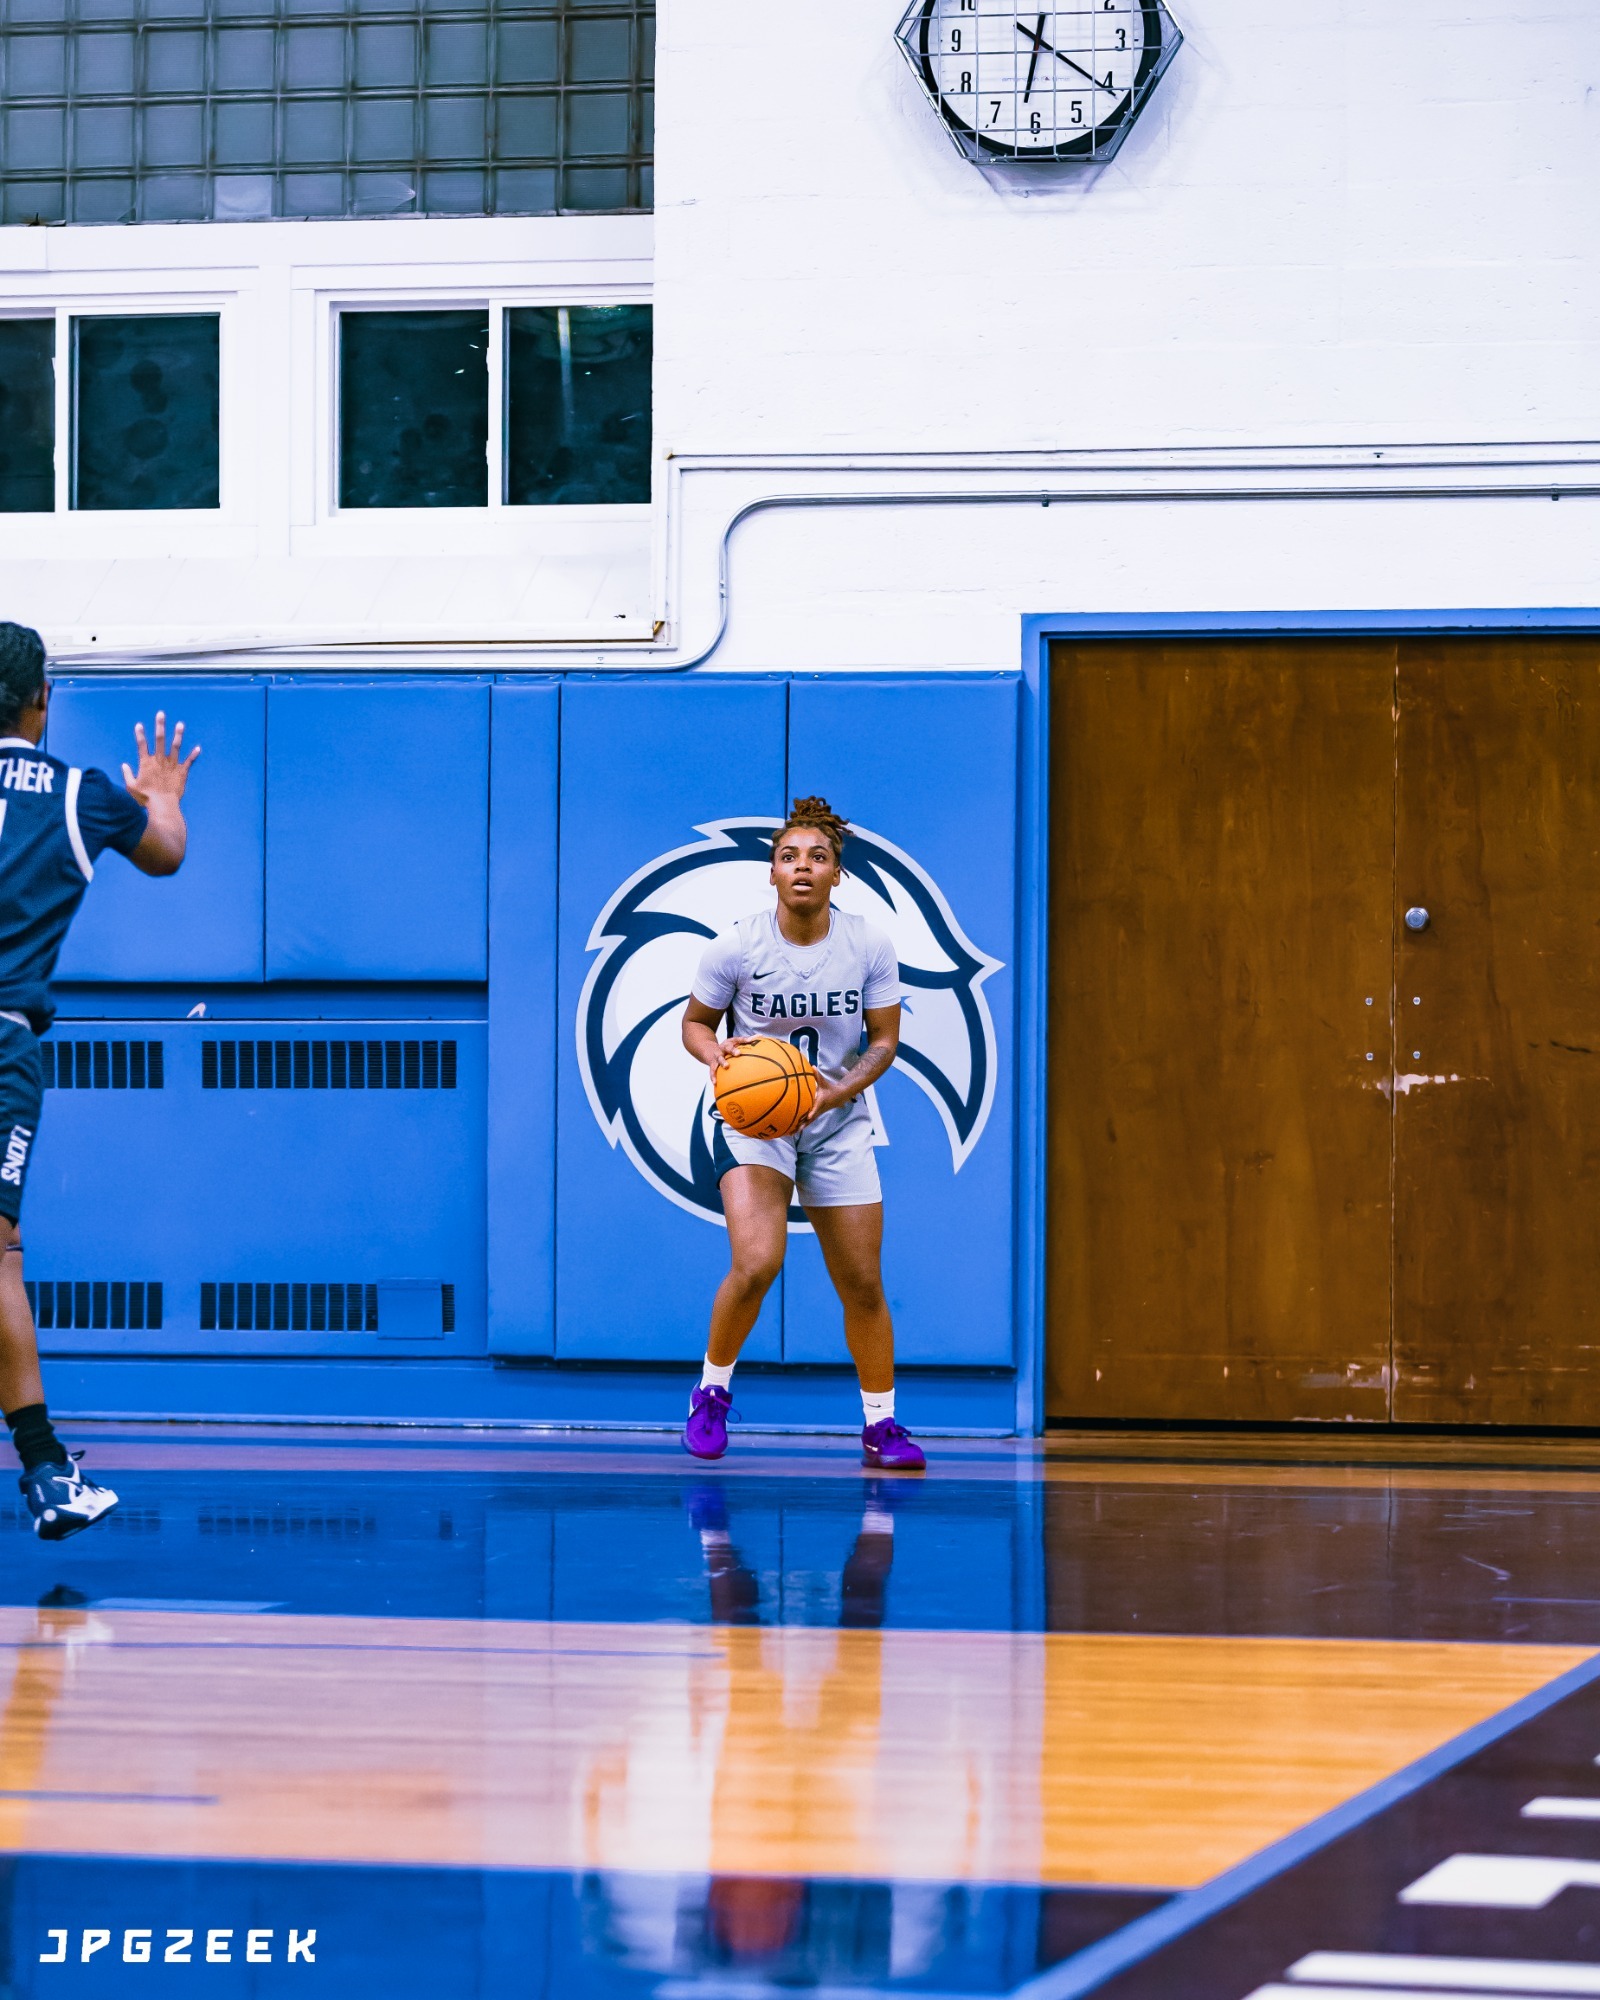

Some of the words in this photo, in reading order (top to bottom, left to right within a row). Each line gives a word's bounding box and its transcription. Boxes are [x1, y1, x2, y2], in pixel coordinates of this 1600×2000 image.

[951, 29, 962, 52] 9
[1114, 28, 1126, 52] 3
[961, 71, 972, 93] 8
[1101, 70, 1114, 90] 4
[990, 101, 1002, 123] 7
[1029, 112, 1041, 134] 6
[1070, 101, 1082, 123] 5
[750, 989, 861, 1018] EAGLES
[0, 1124, 32, 1186] LIONS
